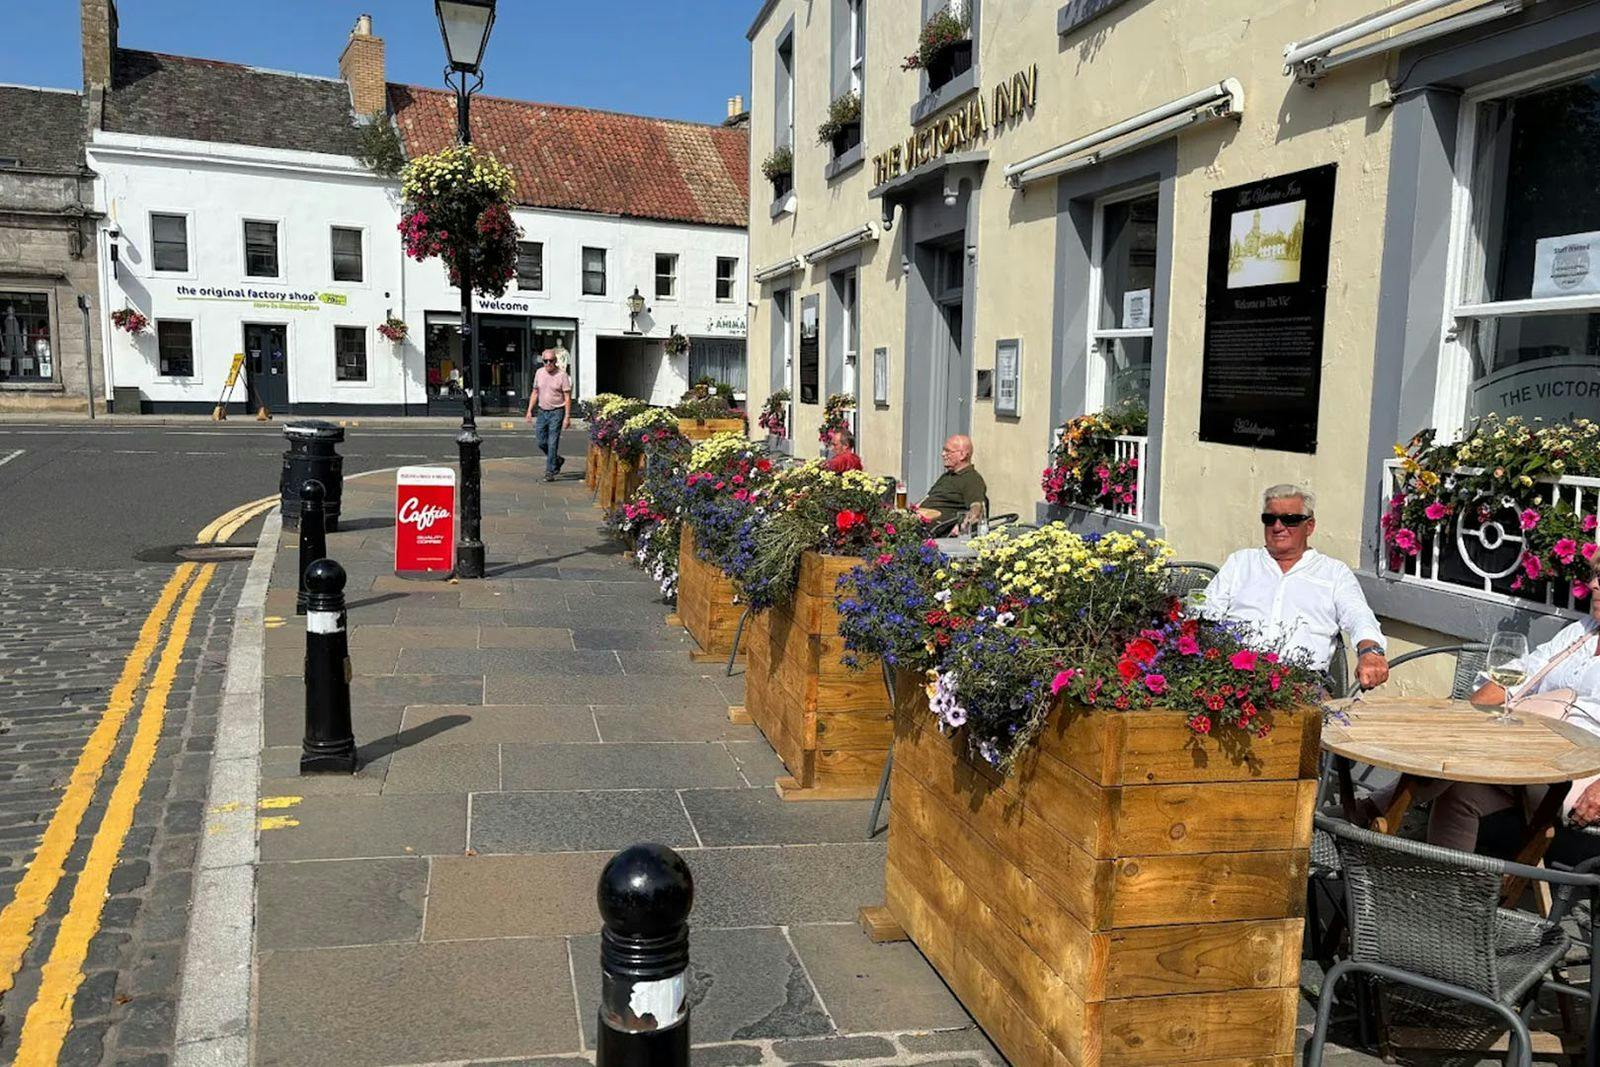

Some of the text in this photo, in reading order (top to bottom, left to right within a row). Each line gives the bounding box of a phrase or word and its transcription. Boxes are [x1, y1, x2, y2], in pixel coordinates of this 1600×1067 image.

[872, 62, 1037, 187] THE VICTORIA INN
[177, 285, 197, 296] the
[198, 286, 246, 299] original
[247, 288, 287, 301] factory
[288, 292, 316, 302] shop
[479, 299, 529, 312] Welcome
[1500, 385, 1532, 408] THE
[398, 496, 451, 532] Caffia
